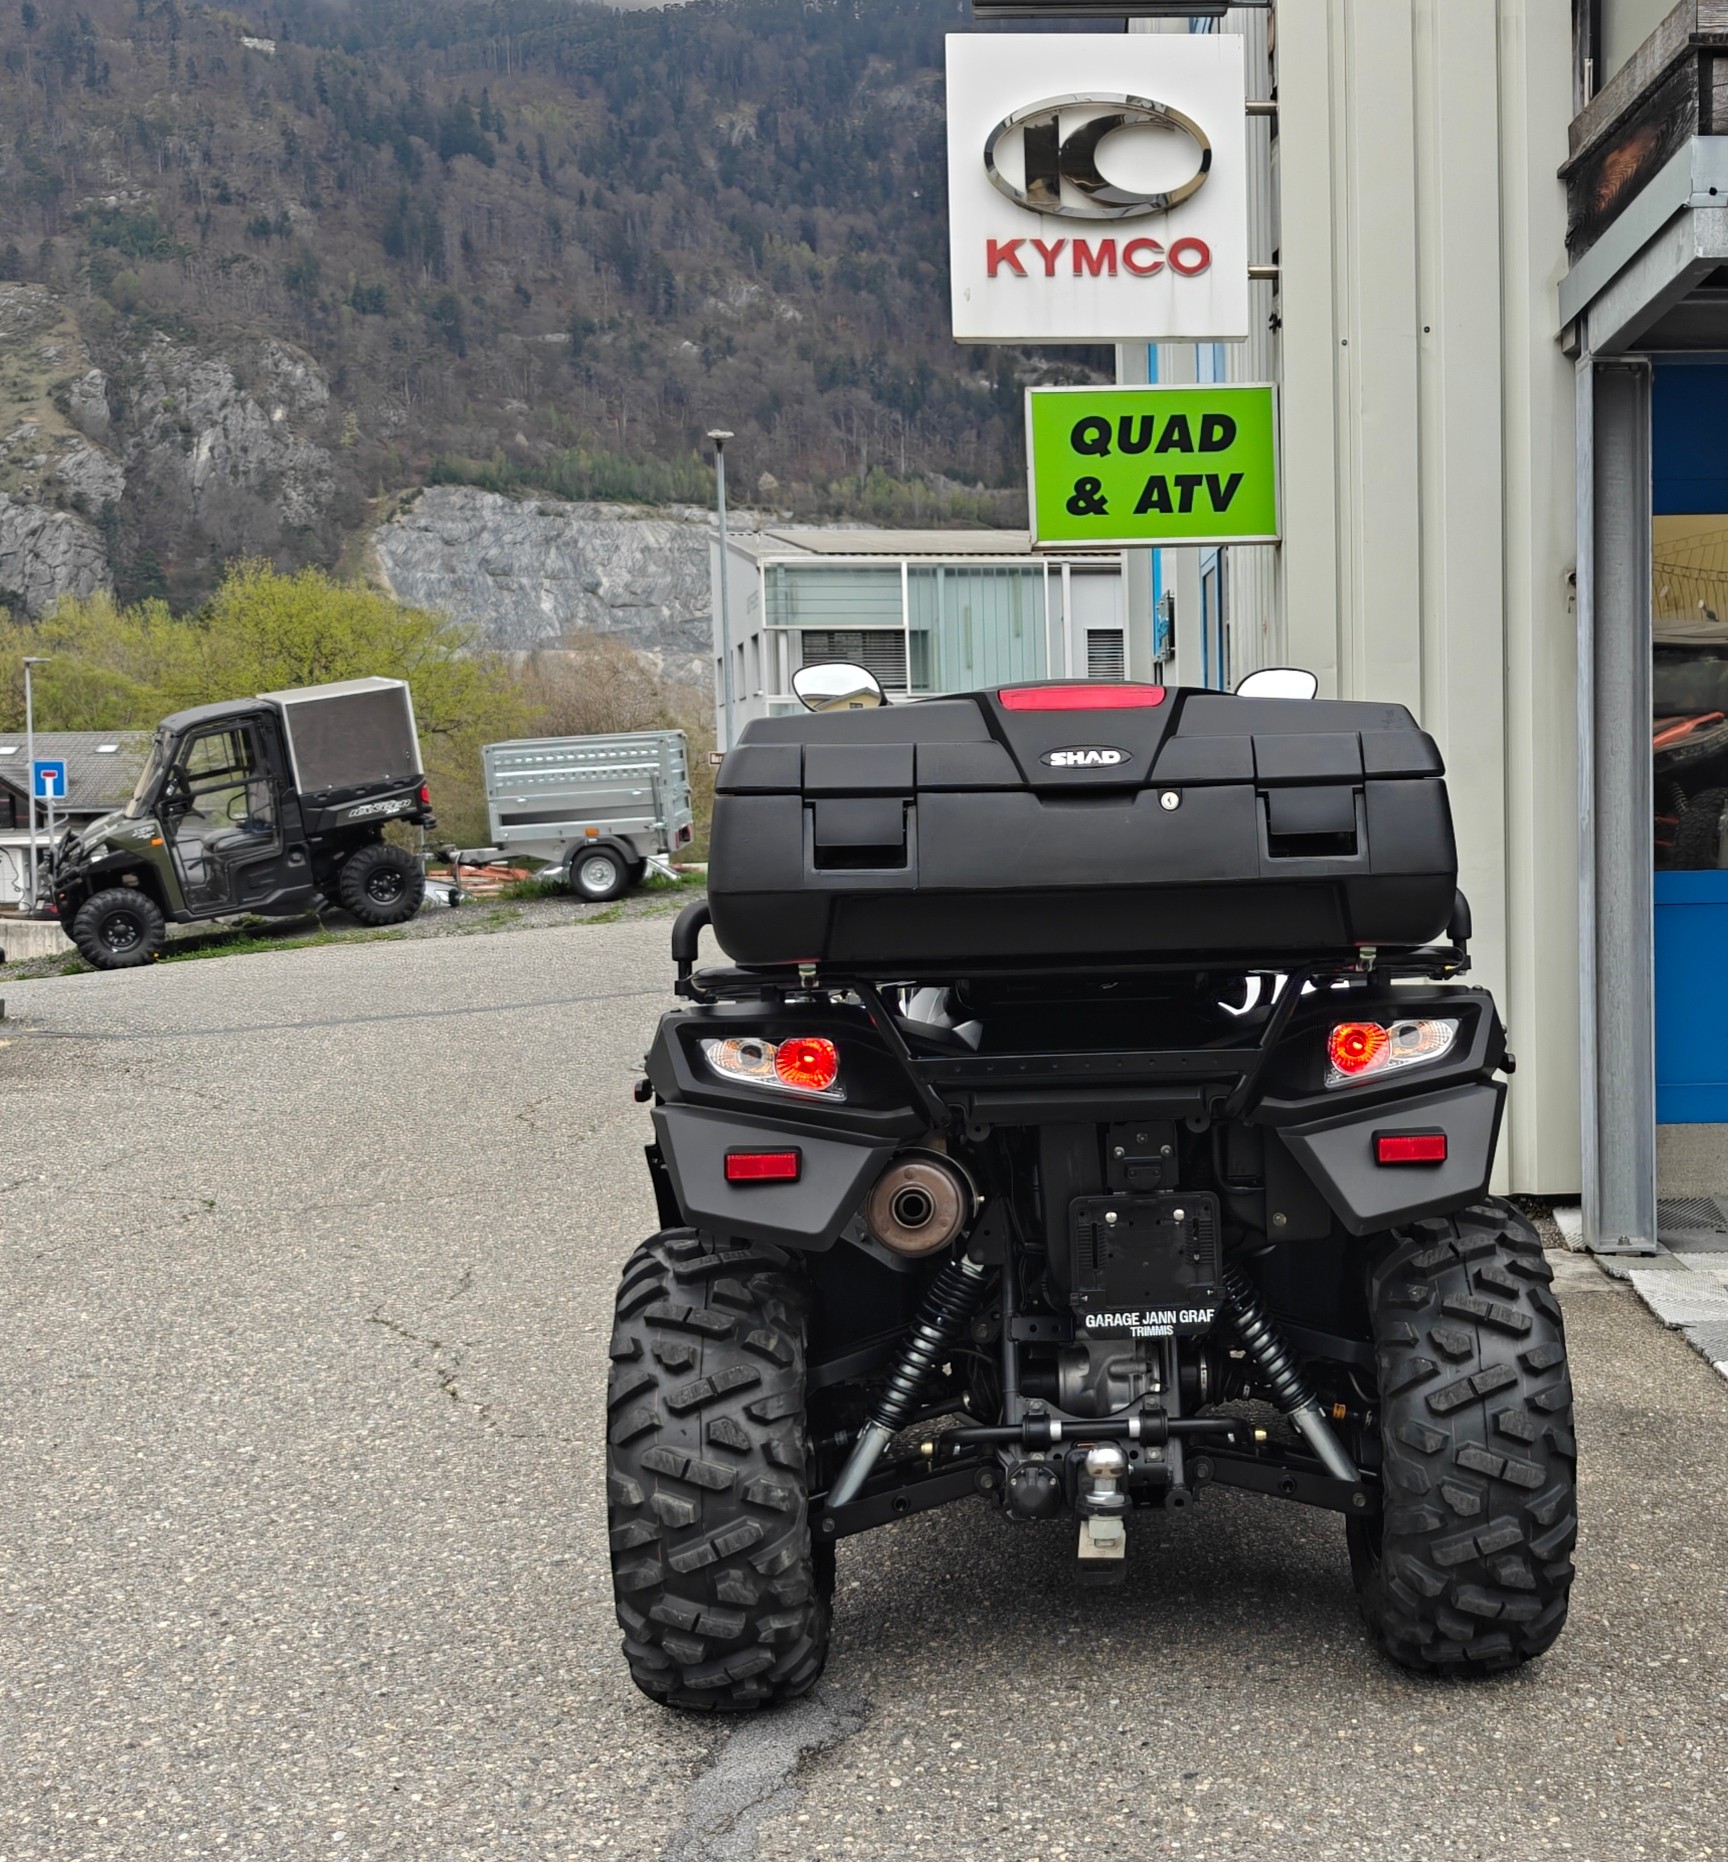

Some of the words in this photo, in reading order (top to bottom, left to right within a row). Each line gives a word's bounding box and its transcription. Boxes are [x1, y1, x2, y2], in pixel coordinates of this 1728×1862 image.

[986, 237, 1212, 277] KYMCO
[1070, 413, 1237, 457] QUAD
[1066, 476, 1108, 516] &
[1133, 472, 1244, 515] ATV
[1050, 750, 1122, 766] SHAD
[1085, 1313, 1140, 1328] GARAGE
[1142, 1310, 1177, 1324] JANN
[1179, 1309, 1215, 1323] GRAF
[1130, 1325, 1174, 1338] TRIMMIS
